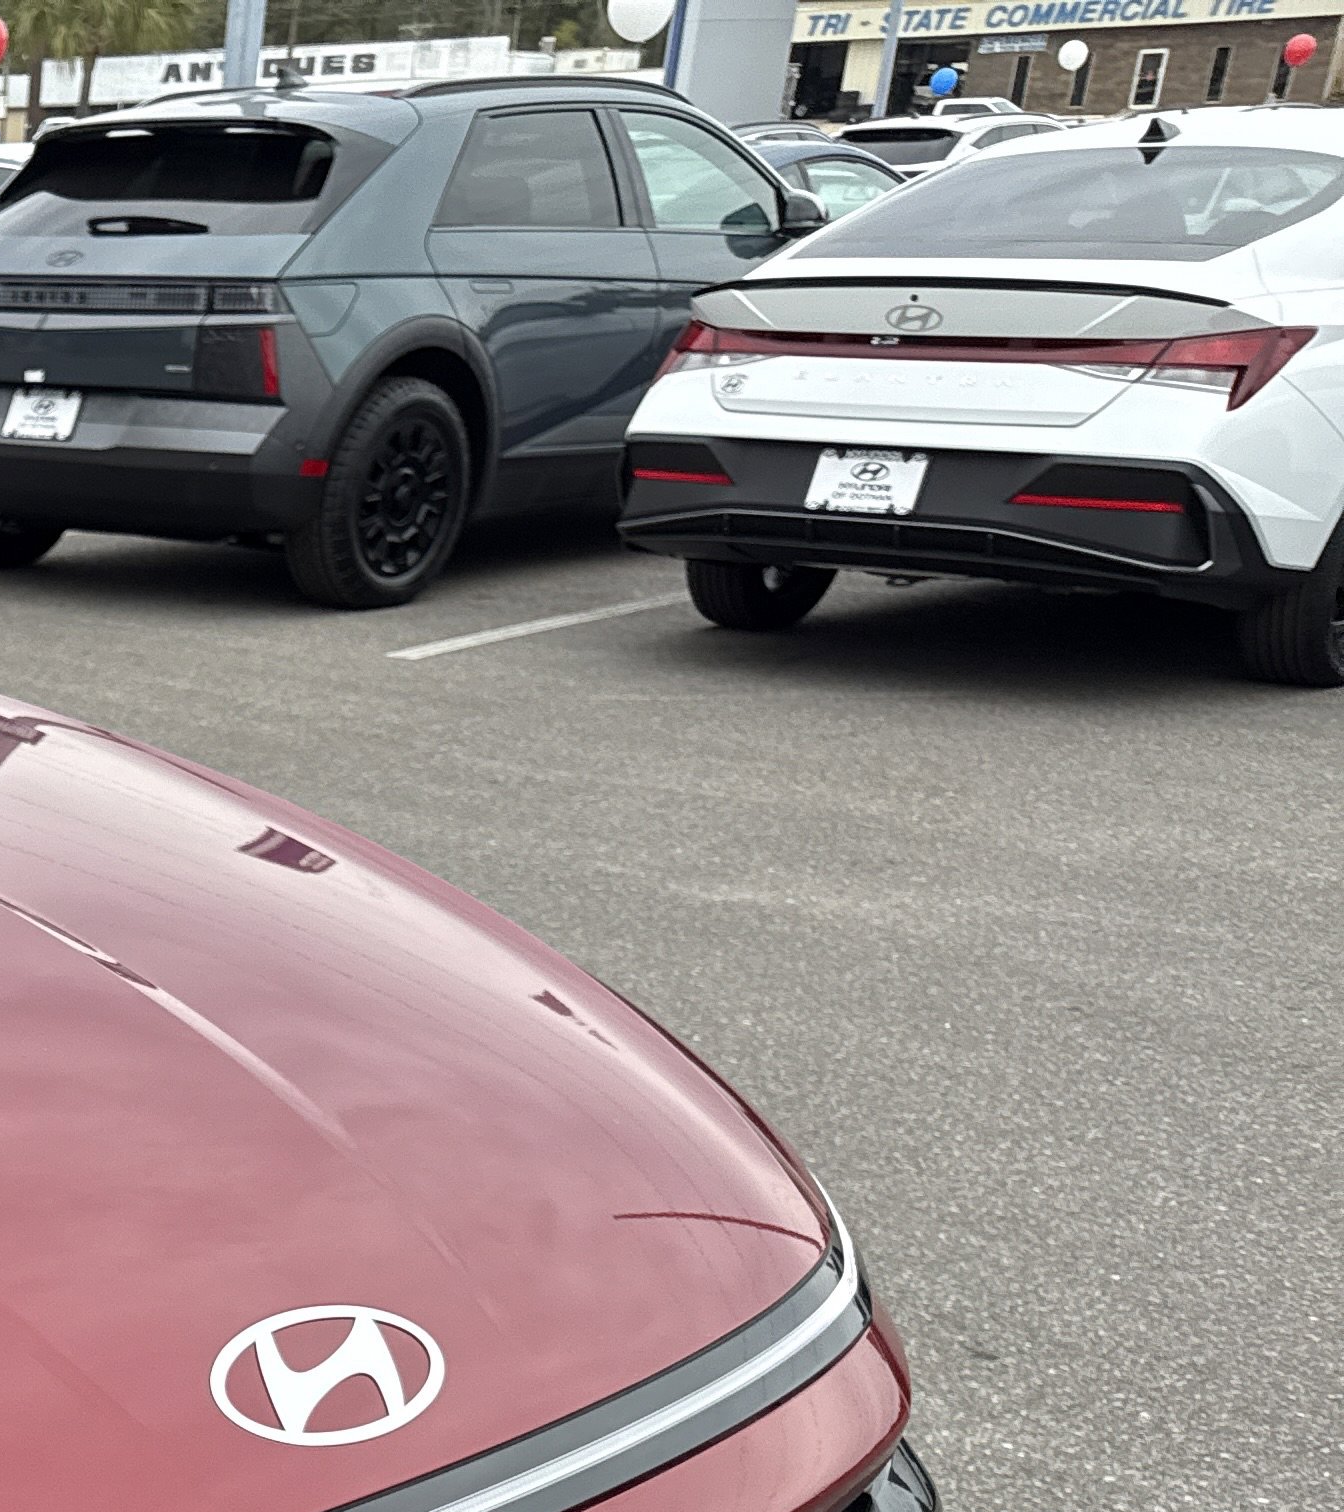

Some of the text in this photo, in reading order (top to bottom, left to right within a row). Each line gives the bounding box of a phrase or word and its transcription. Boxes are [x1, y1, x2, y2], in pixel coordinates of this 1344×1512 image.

[807, 12, 852, 37] TRI
[985, 0, 1189, 29] COMMERCIAL
[161, 52, 377, 84] ANQUES
